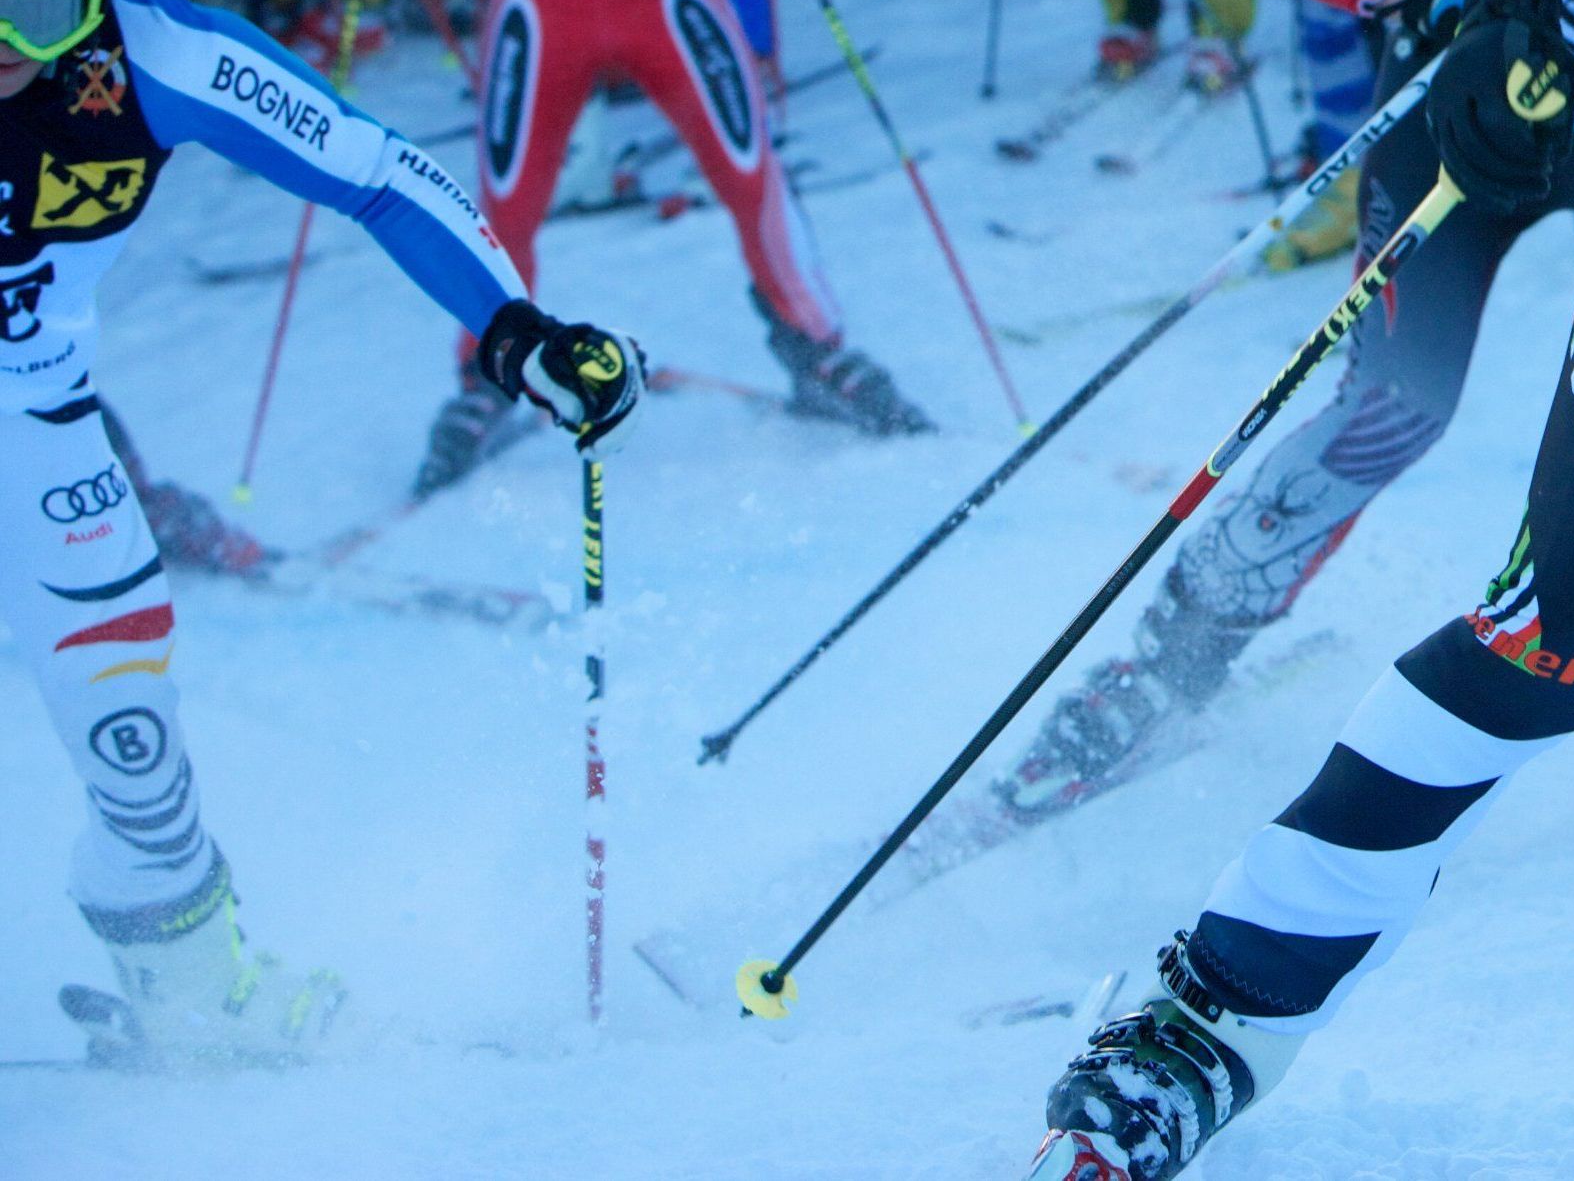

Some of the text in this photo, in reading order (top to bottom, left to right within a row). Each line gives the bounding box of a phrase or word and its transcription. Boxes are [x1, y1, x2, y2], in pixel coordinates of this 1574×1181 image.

[211, 55, 331, 151] BOGNER
[1323, 264, 1389, 343] LEKI
[64, 522, 113, 545] Audi
